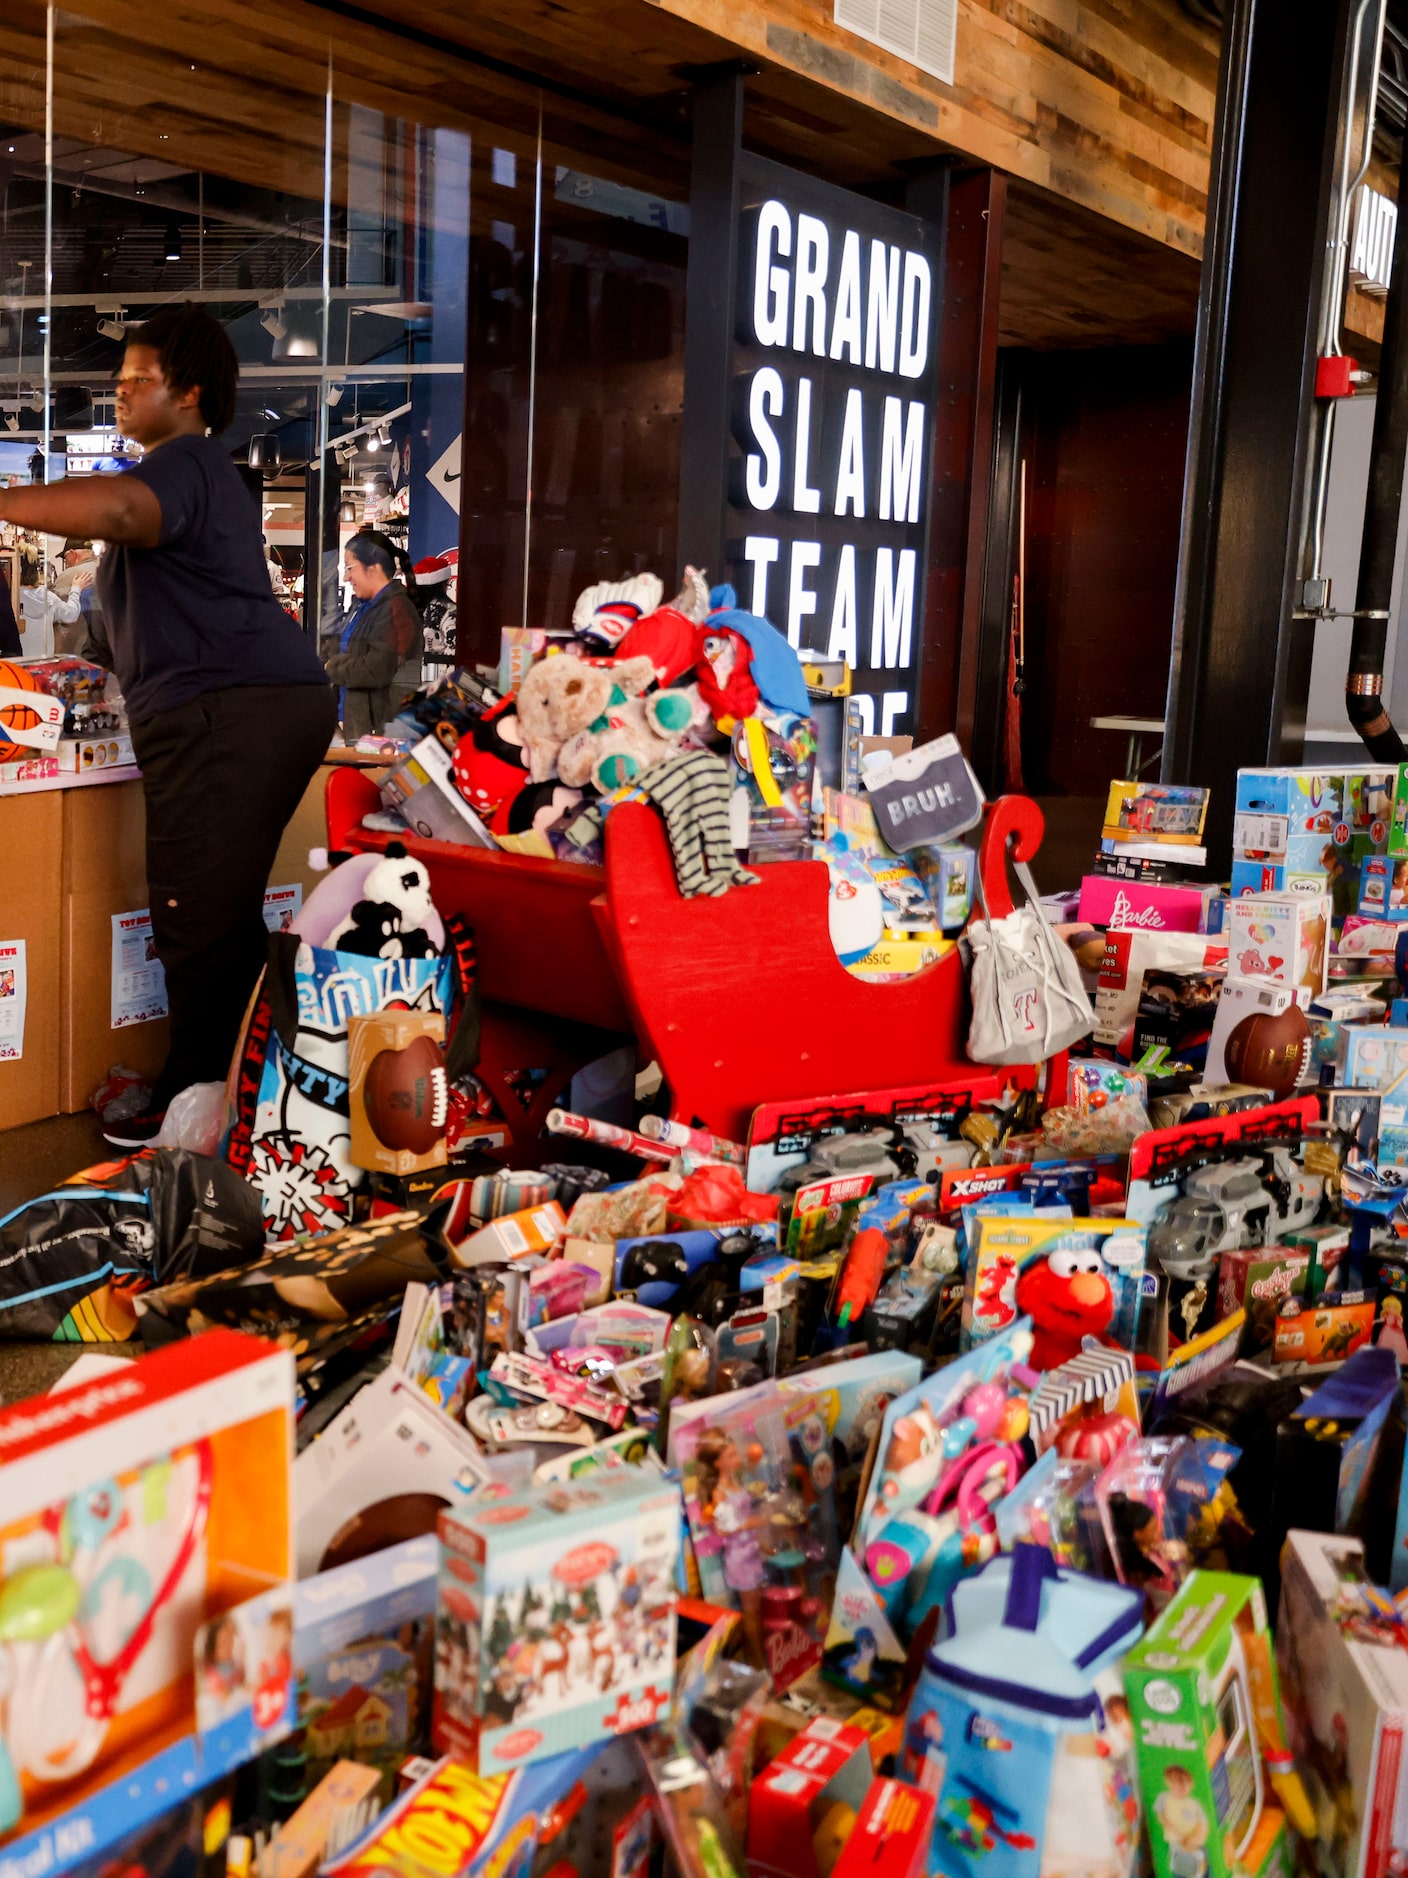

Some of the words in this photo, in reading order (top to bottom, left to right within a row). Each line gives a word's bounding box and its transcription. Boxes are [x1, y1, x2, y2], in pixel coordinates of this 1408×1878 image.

[753, 200, 932, 380] GRAND
[744, 366, 926, 525] SLAM
[743, 536, 917, 671] TEAM
[1110, 890, 1166, 929] Barbie
